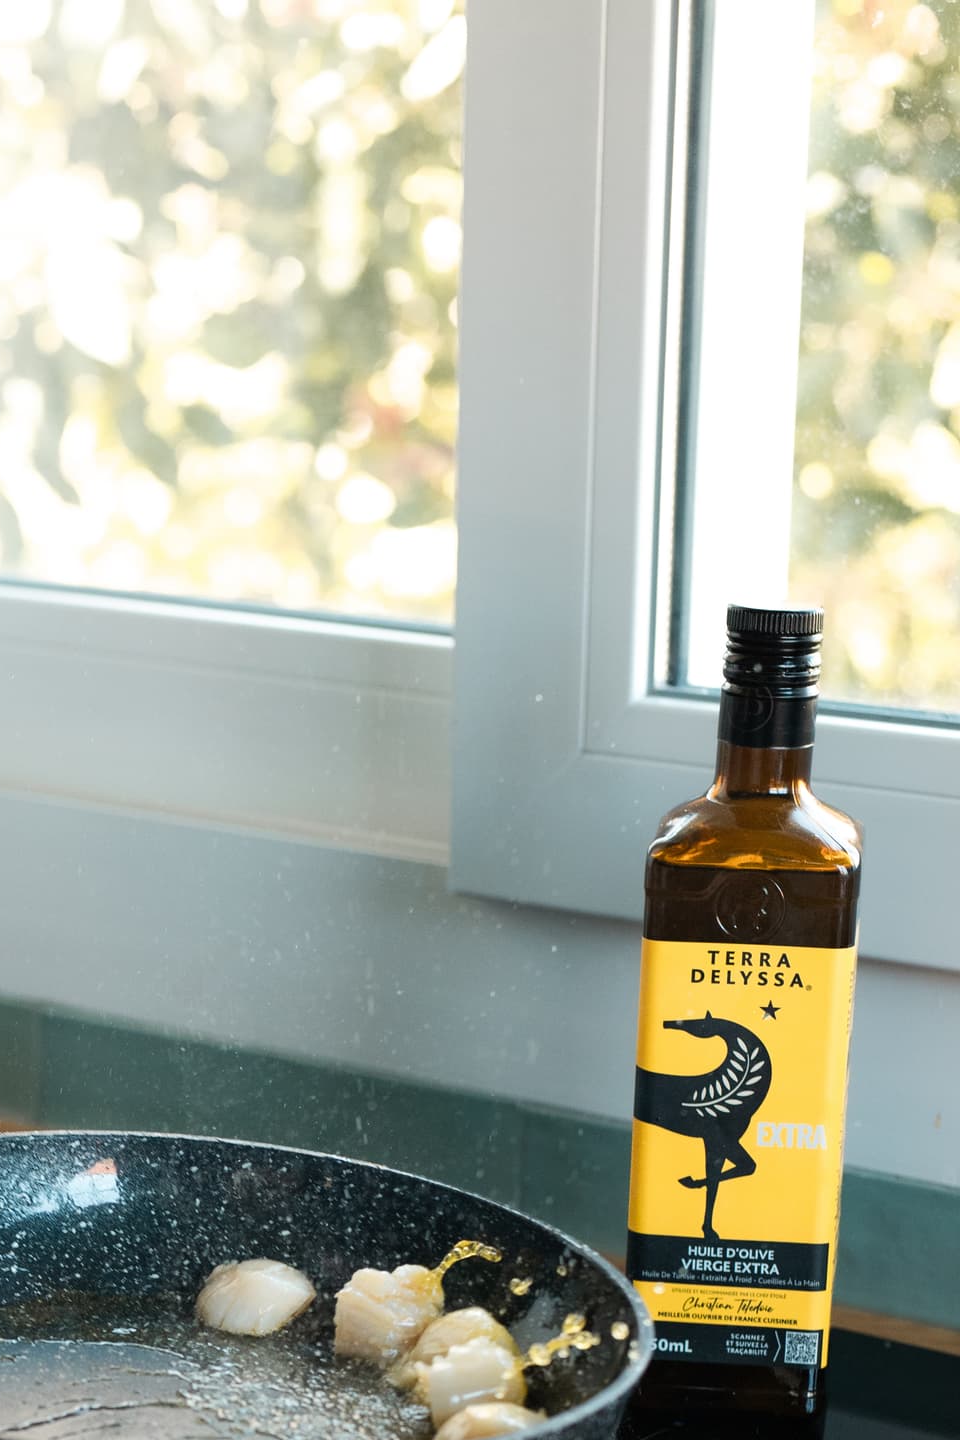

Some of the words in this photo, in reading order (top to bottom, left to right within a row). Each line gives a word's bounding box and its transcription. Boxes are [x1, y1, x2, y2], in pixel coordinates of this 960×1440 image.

[708, 950, 791, 968] TERRA
[691, 969, 804, 988] DELYSSA
[756, 1122, 828, 1151] EXTRA
[688, 1245, 723, 1258] HUILE
[726, 1247, 775, 1261] D'OLIVE
[681, 1258, 731, 1273] VIERGE
[734, 1261, 780, 1276] EXTRA
[642, 1269, 660, 1279] Huile
[661, 1271, 671, 1279] De
[701, 1273, 727, 1283] Extraite
[735, 1275, 753, 1284] Froid
[803, 1279, 820, 1288] Main
[682, 1296, 734, 1312] Christian
[657, 1311, 690, 1319] MEILLEUR
[691, 1312, 722, 1321] OUVRIER
[734, 1315, 761, 1323] FRANCE
[762, 1317, 798, 1326] CUISINIER
[649, 1337, 693, 1353] 50mL
[725, 1339, 734, 1347] ET
[735, 1340, 759, 1349] SUIVEZ
[760, 1341, 769, 1349] LA
[730, 1332, 766, 1342] SCANNEZ
